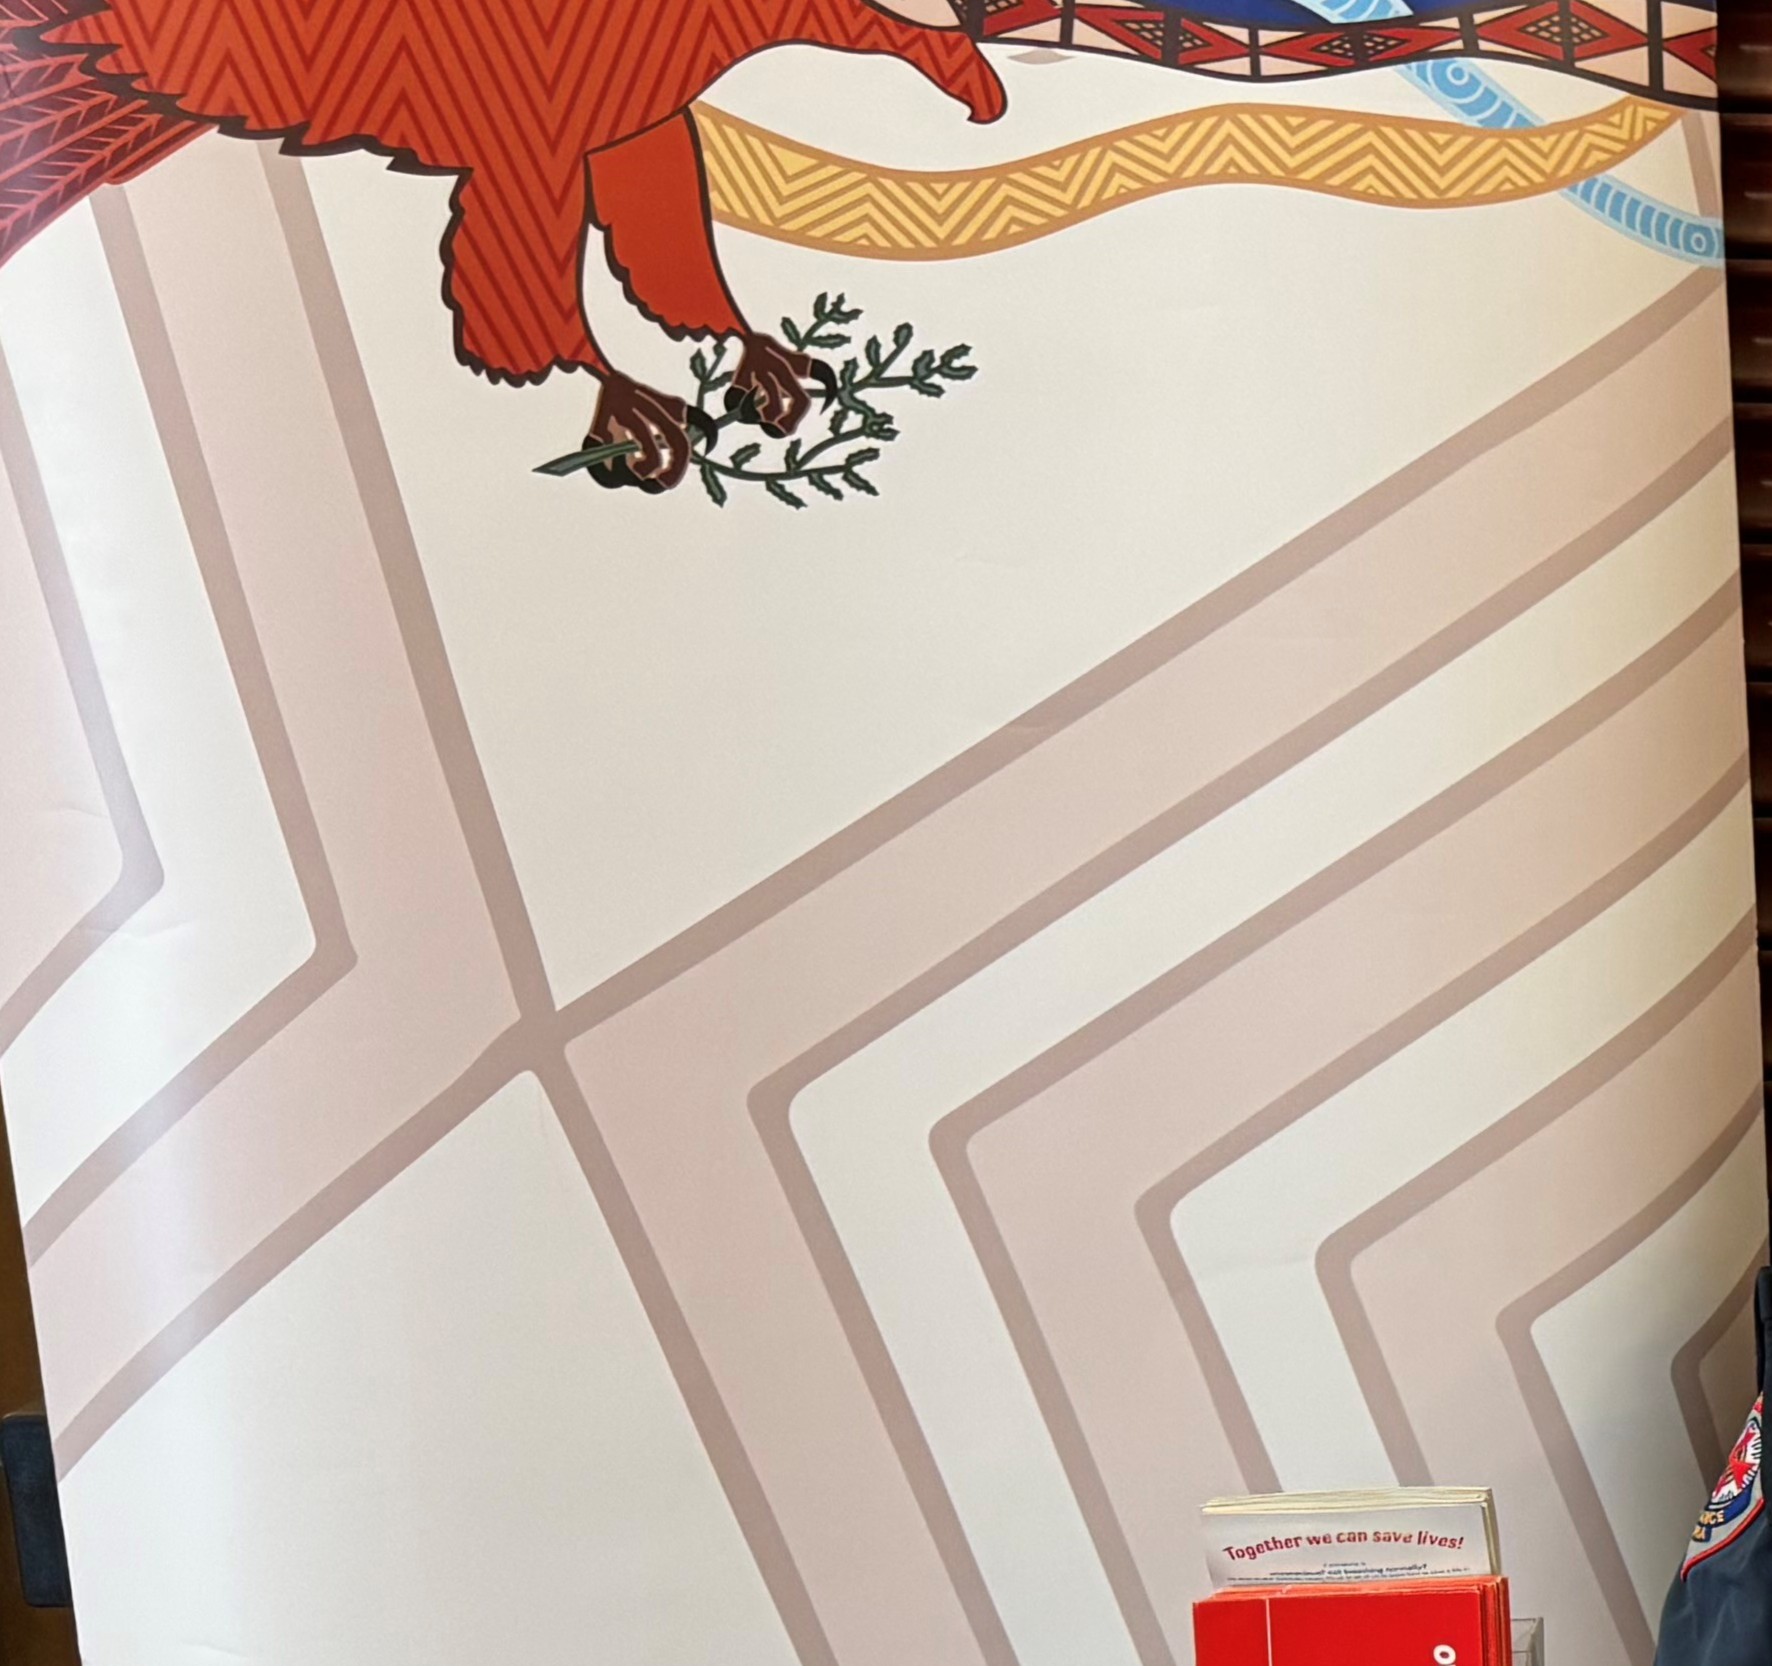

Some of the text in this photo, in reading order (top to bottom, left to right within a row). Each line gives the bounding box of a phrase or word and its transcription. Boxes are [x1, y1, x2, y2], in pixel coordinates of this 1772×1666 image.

[1223, 1529, 1464, 1563] Together we can save lives!
